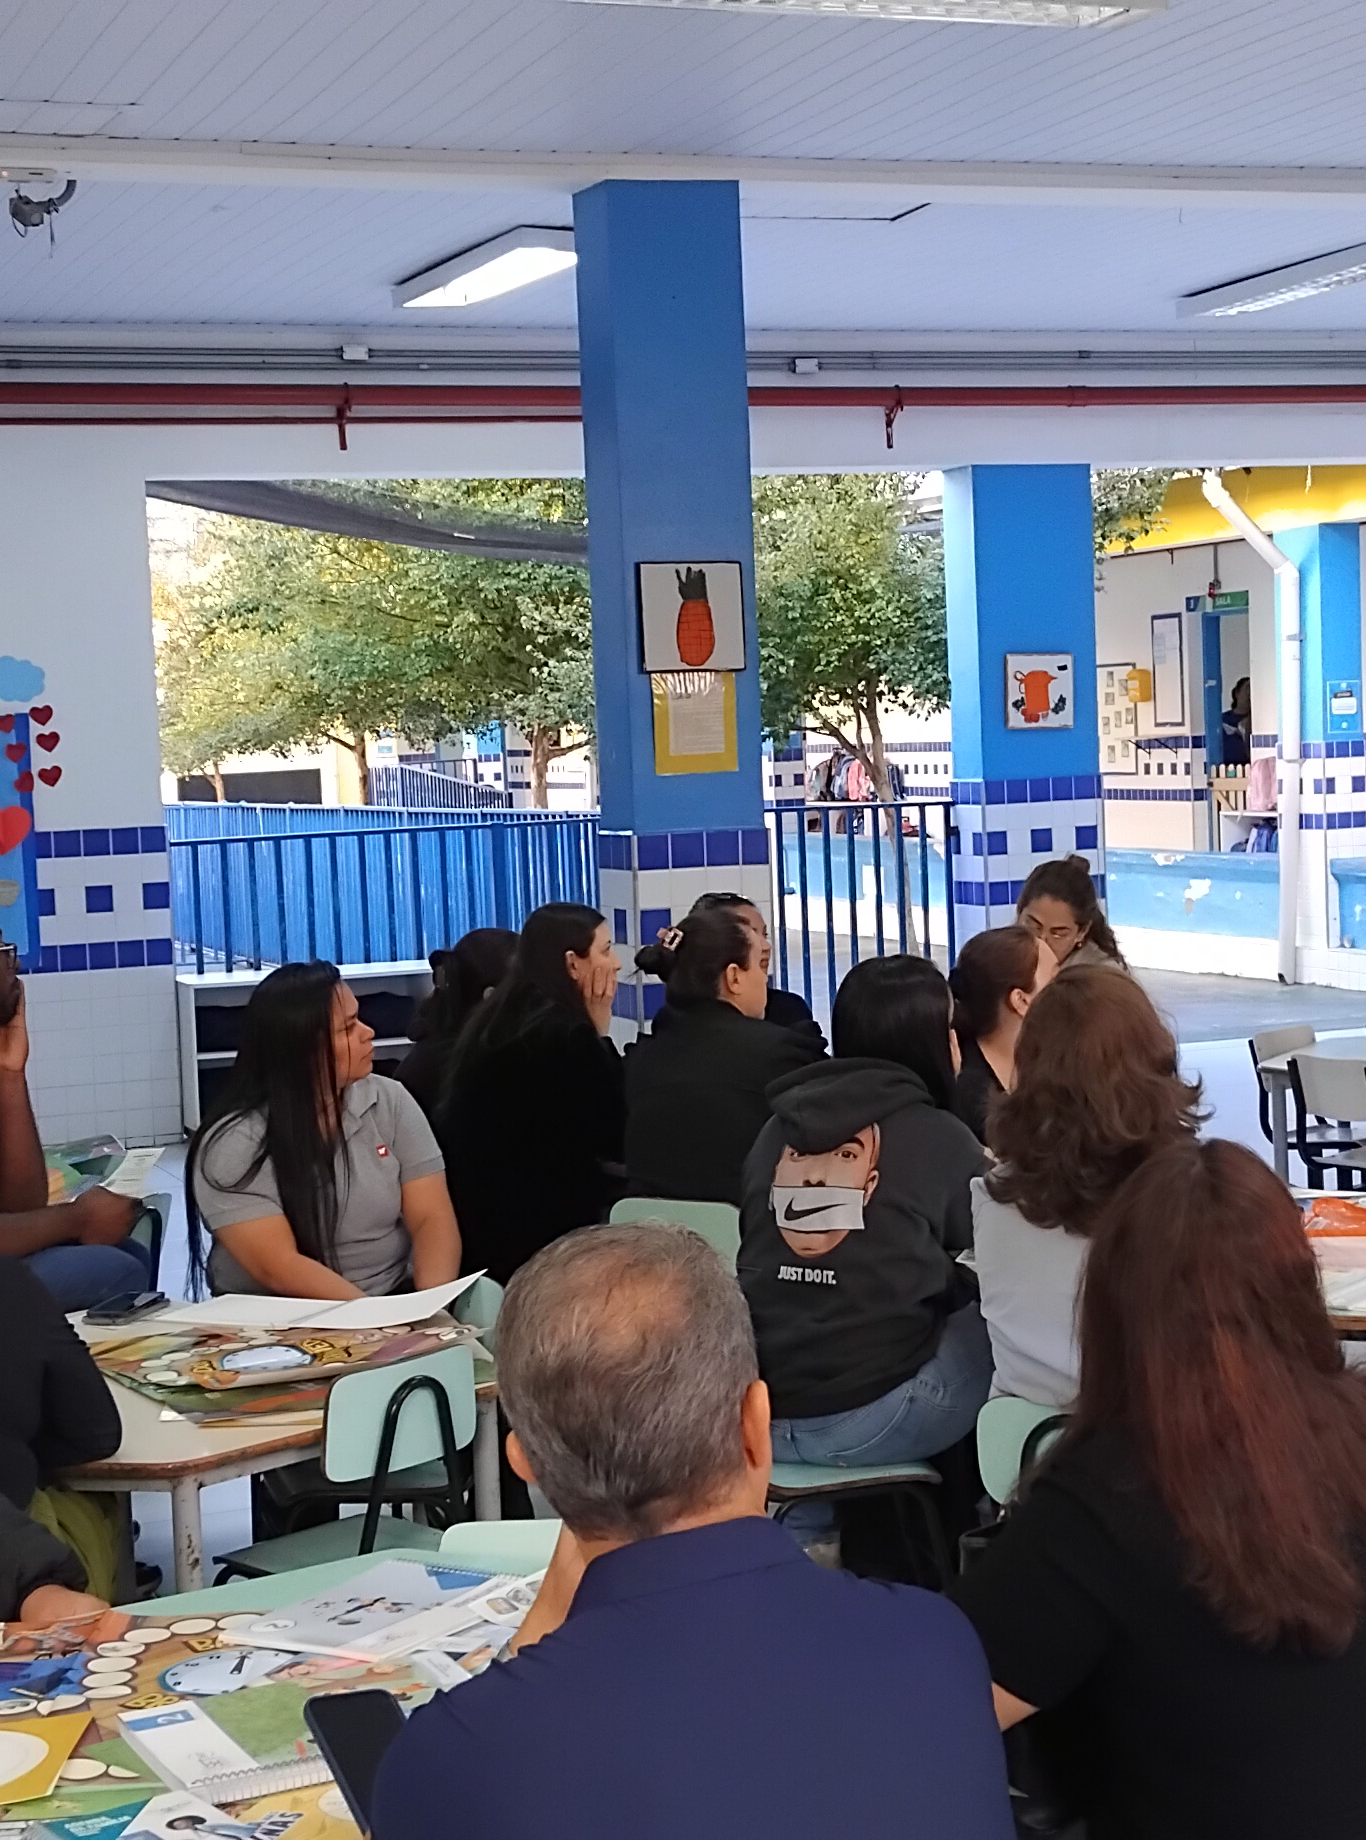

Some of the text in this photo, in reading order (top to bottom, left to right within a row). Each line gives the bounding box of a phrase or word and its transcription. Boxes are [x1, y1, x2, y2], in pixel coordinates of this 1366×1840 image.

[777, 1265, 837, 1285] JUST DO IT.
